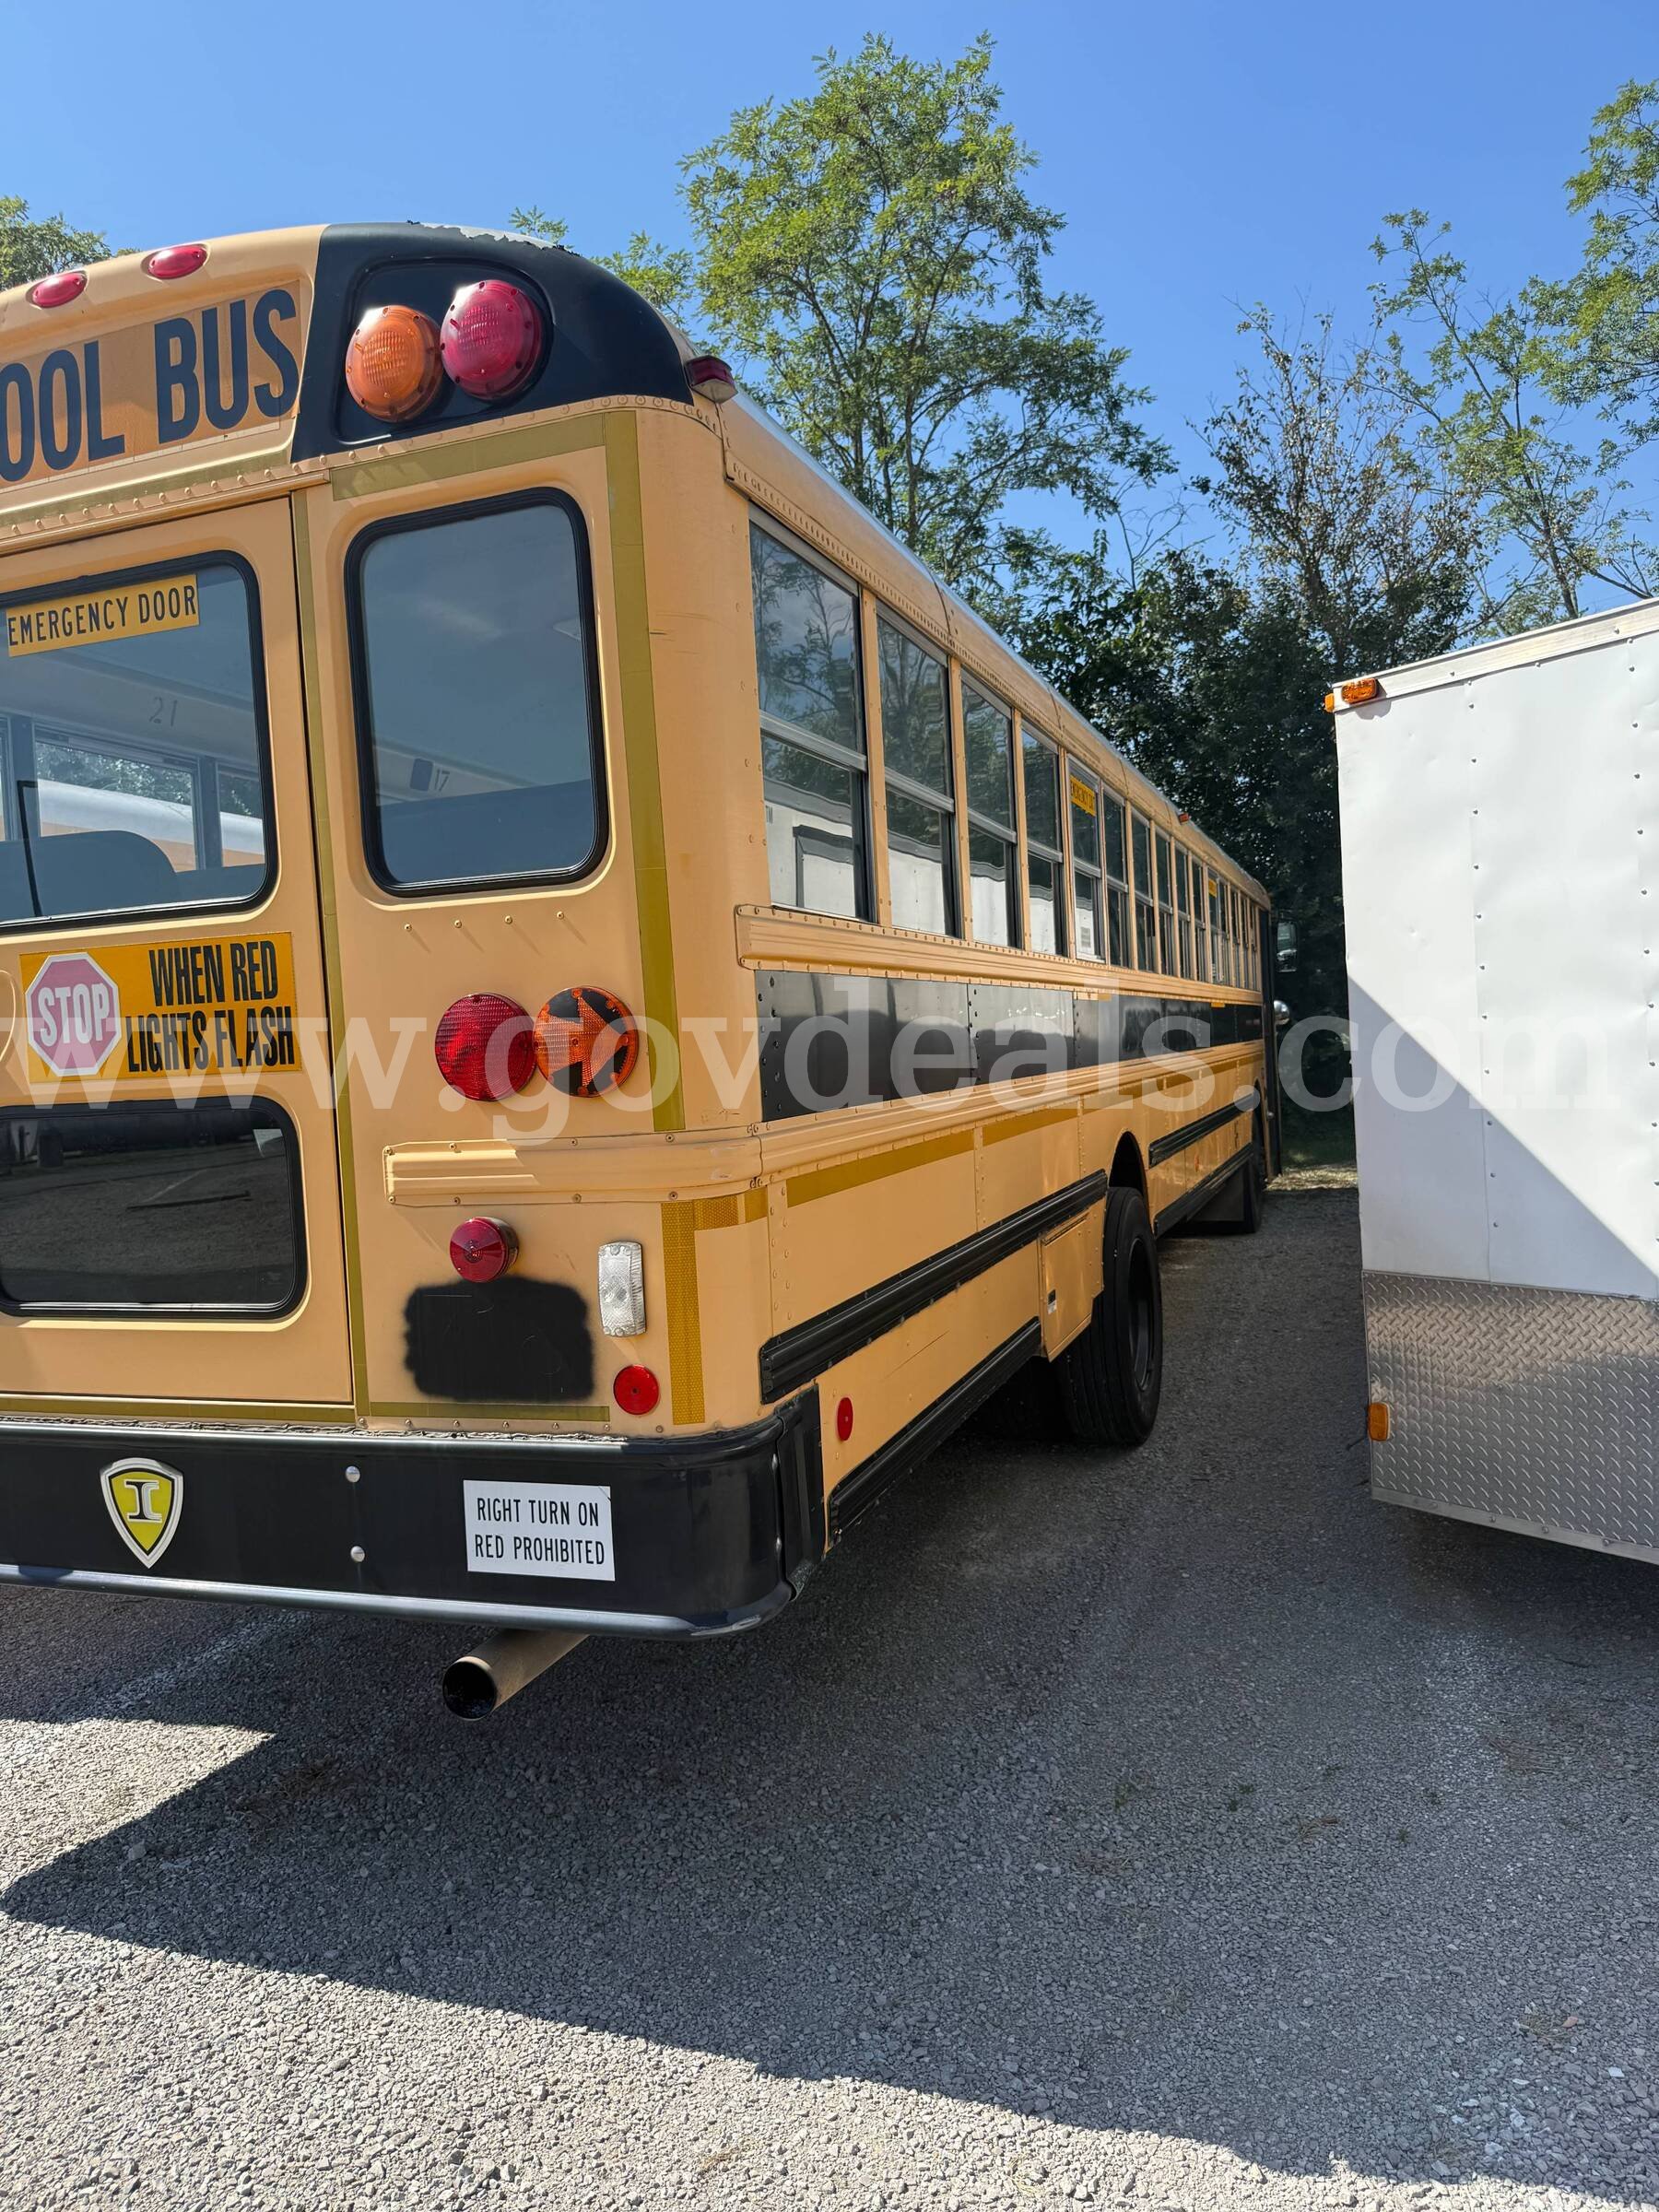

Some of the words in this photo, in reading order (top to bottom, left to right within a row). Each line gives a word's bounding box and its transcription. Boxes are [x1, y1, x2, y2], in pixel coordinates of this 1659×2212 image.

[154, 288, 300, 444] BUS
[7, 597, 129, 646] EMERGENCY
[138, 585, 196, 624] DOOR
[148, 697, 178, 726] 21
[148, 944, 225, 1007] WHEN
[229, 940, 278, 1002] RED
[38, 982, 111, 1047] STOP
[125, 1010, 208, 1073] LIGHTS
[214, 1006, 295, 1068] FLASH
[477, 1497, 521, 1523] RIGHT
[528, 1500, 570, 1525] TURN
[578, 1501, 599, 1527] ON
[475, 1534, 504, 1559] RED
[513, 1535, 605, 1565] PROHIBITED
